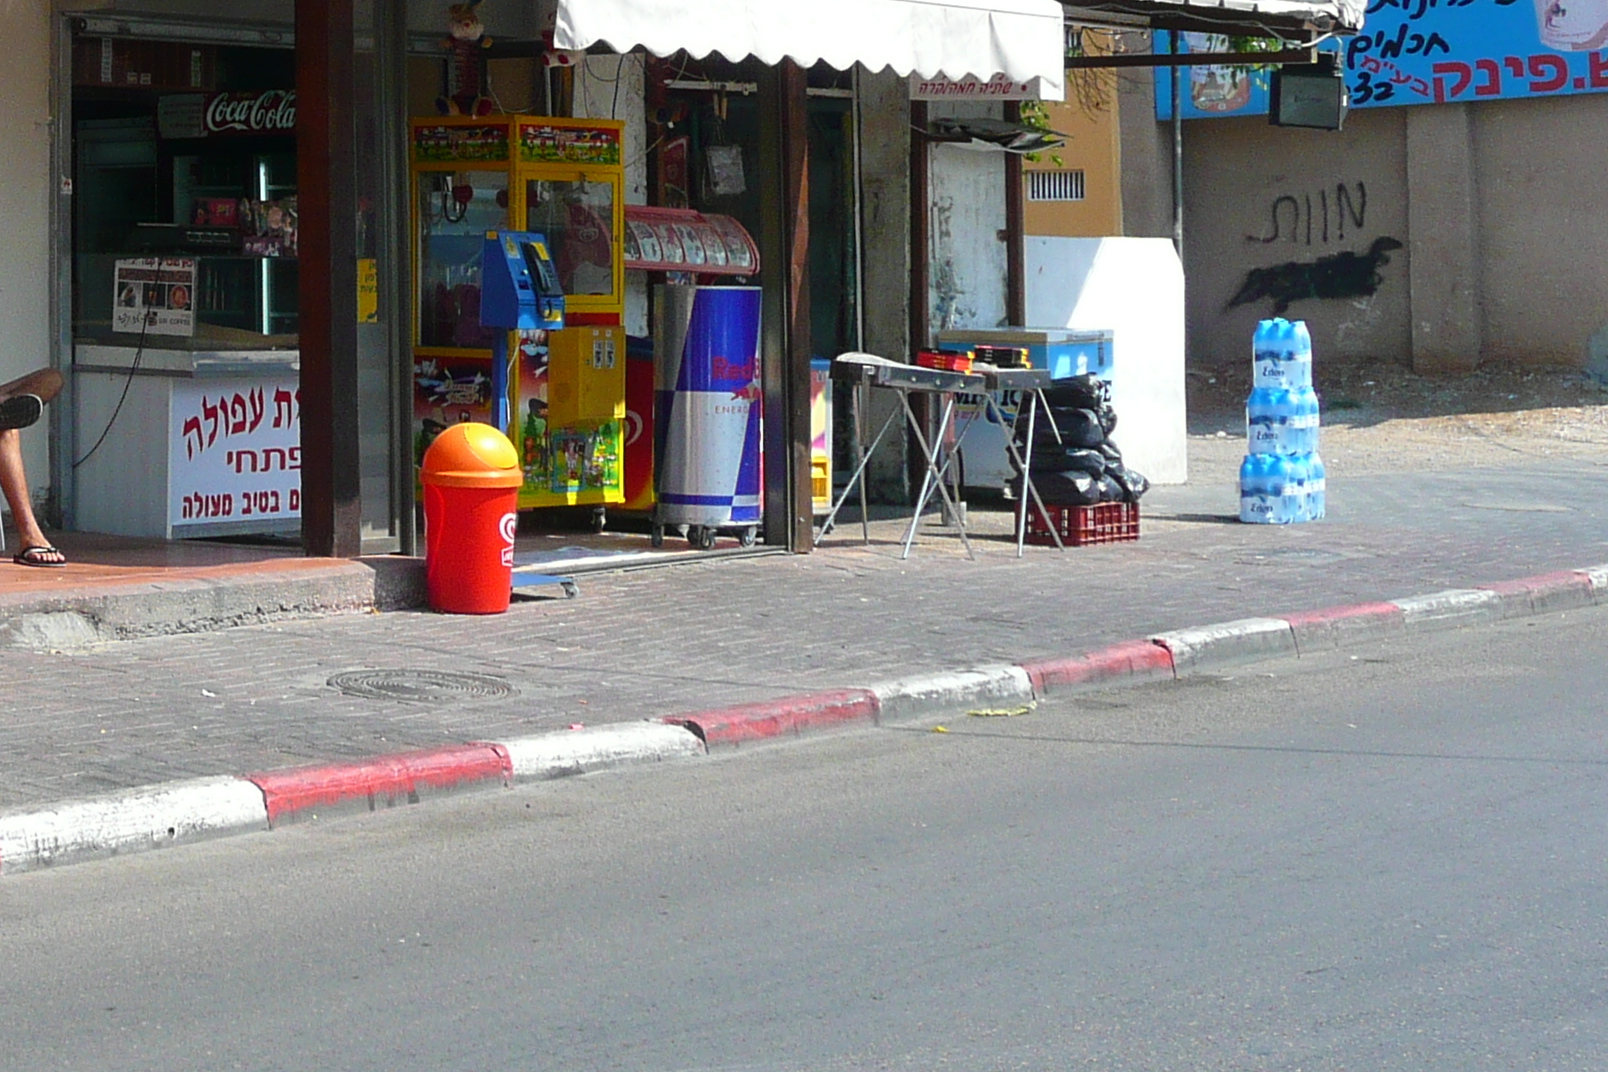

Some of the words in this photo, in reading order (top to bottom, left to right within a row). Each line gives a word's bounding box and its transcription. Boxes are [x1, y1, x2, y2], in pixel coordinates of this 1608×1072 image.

[1347, 23, 1450, 70] חכמים
[206, 90, 296, 132] Coca-Cola
[182, 384, 265, 462] עפולה
[182, 491, 233, 519] מעולה
[241, 489, 280, 515] בטיב
